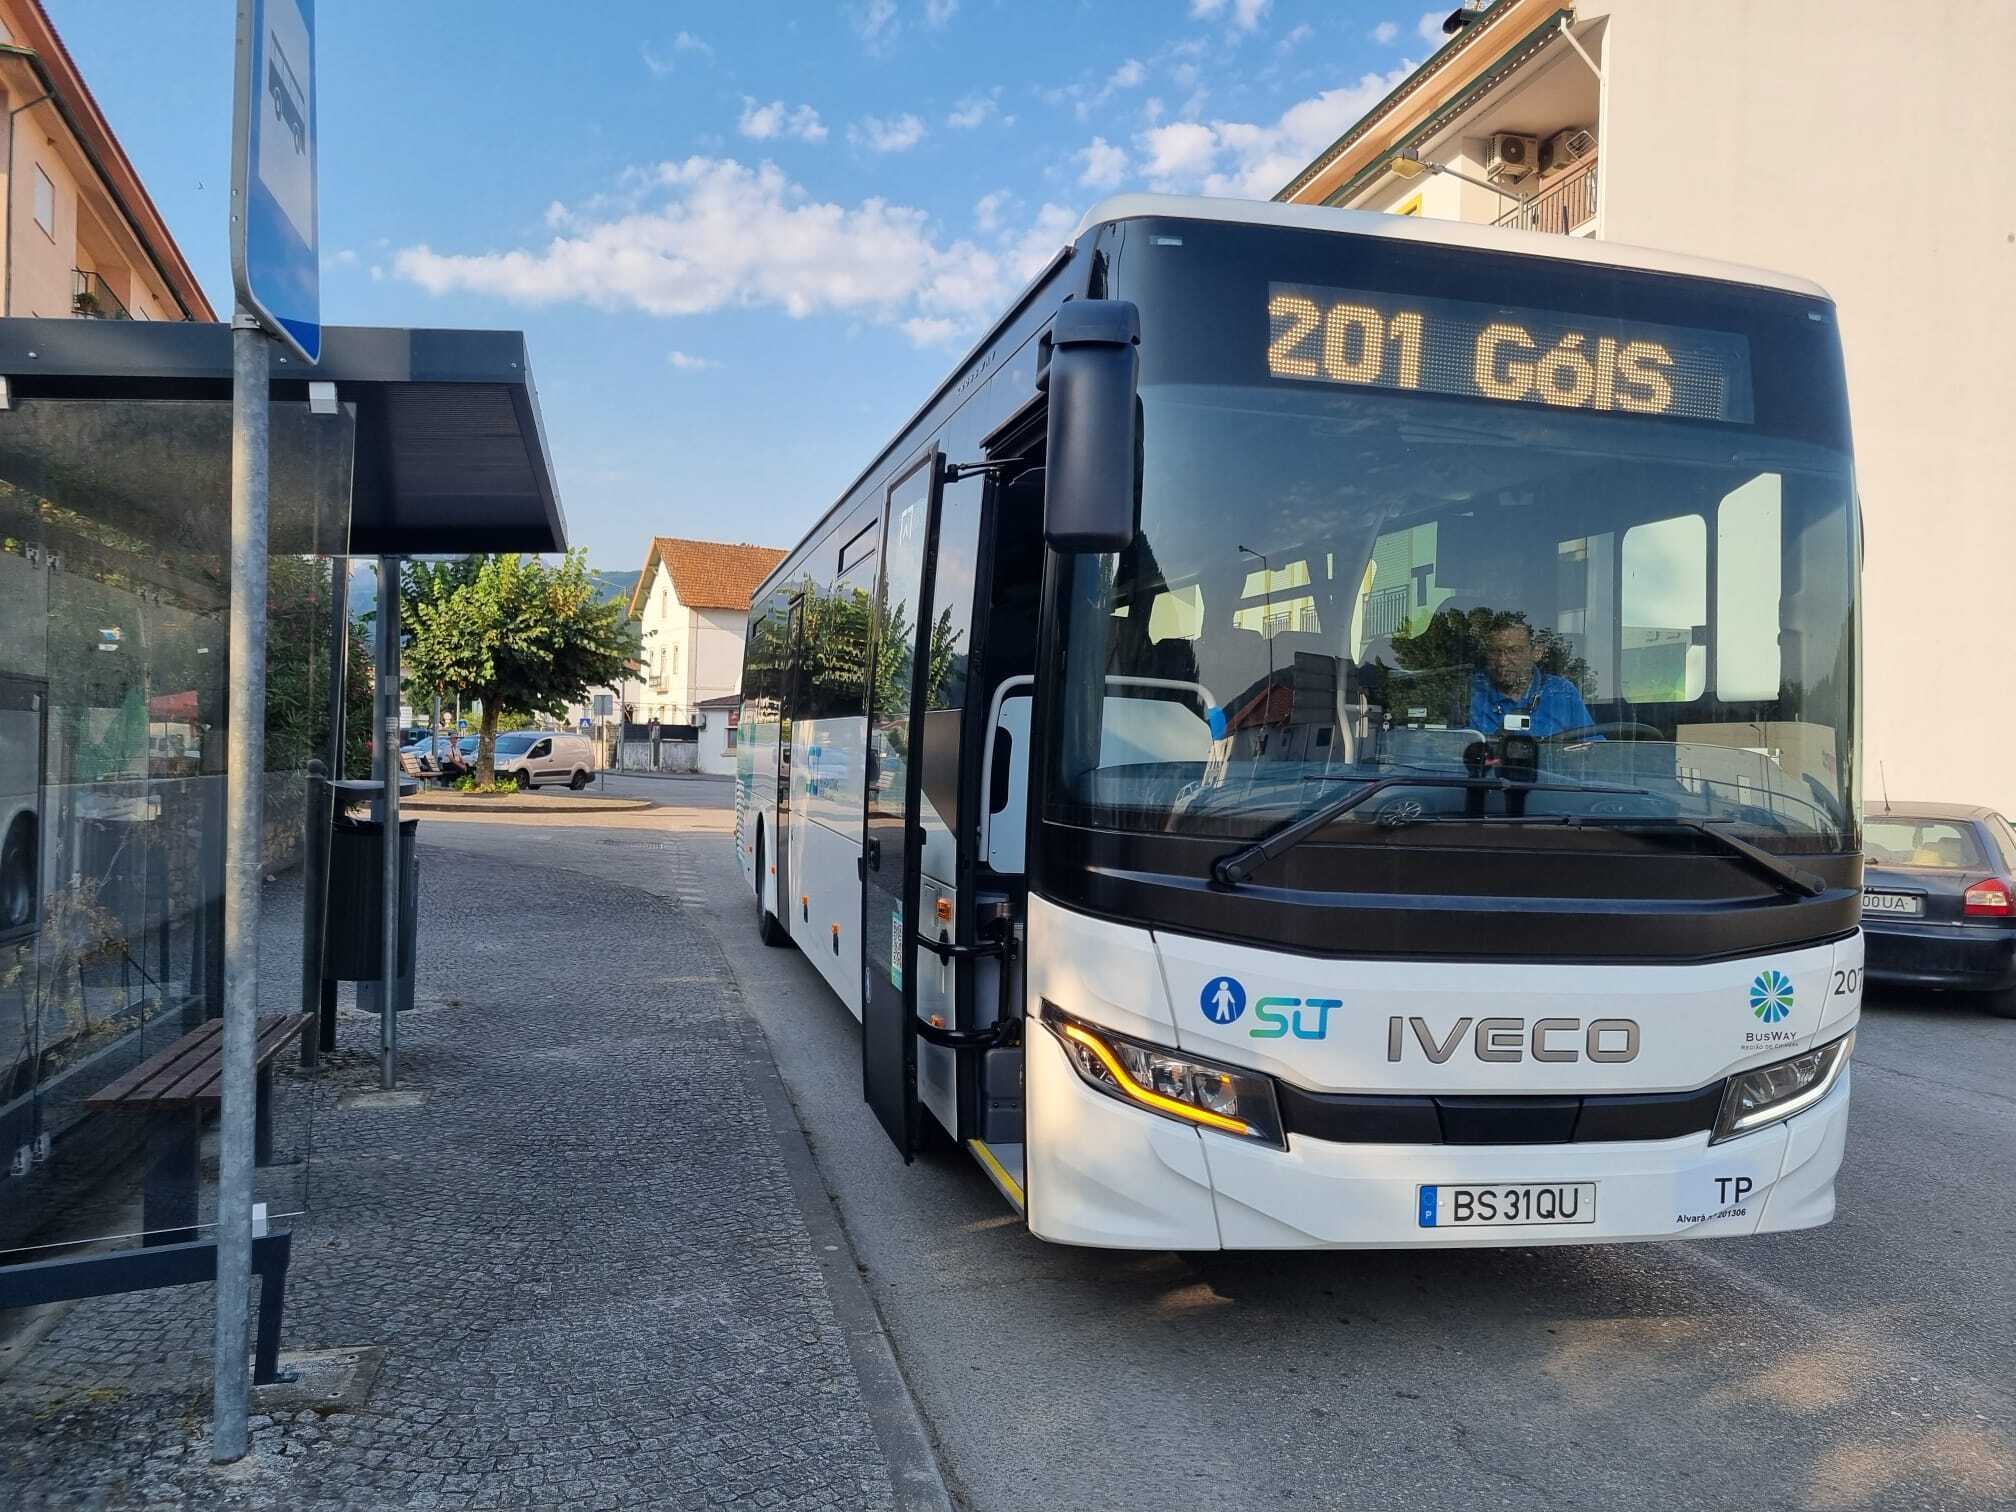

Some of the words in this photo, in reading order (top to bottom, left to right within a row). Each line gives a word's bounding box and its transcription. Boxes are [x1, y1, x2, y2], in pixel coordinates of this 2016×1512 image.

[1267, 295, 1424, 390] 201
[1388, 1016, 1641, 1064] IVECO
[1425, 1210, 1432, 1220] P
[1454, 1187, 1579, 1222] BS31QU
[1714, 1176, 1753, 1204] TP
